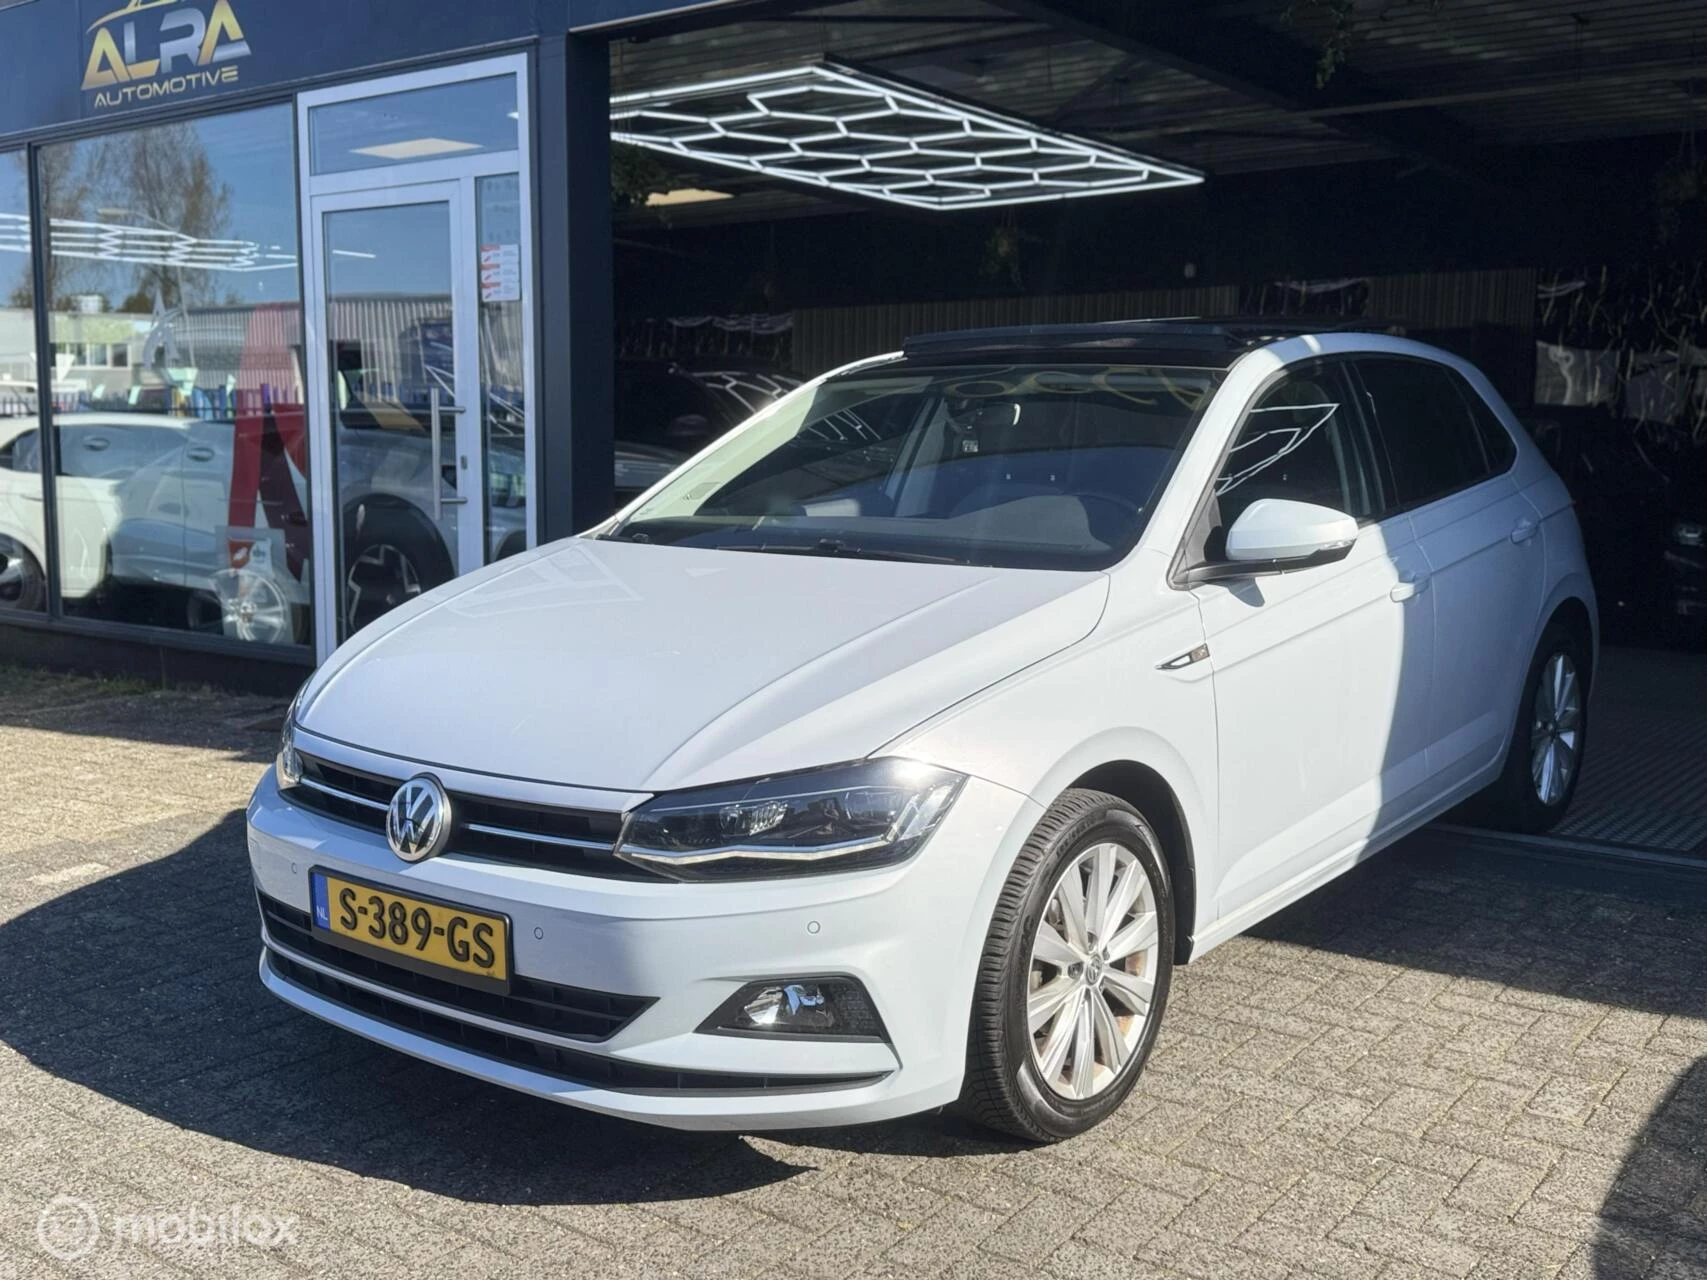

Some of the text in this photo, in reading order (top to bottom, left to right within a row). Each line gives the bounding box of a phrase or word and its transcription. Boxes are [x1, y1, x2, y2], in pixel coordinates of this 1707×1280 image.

[81, 0, 251, 90] ALRA
[94, 65, 239, 108] AUTOMOTIVE
[316, 905, 328, 921] NL
[339, 887, 496, 969] S-389-GS
